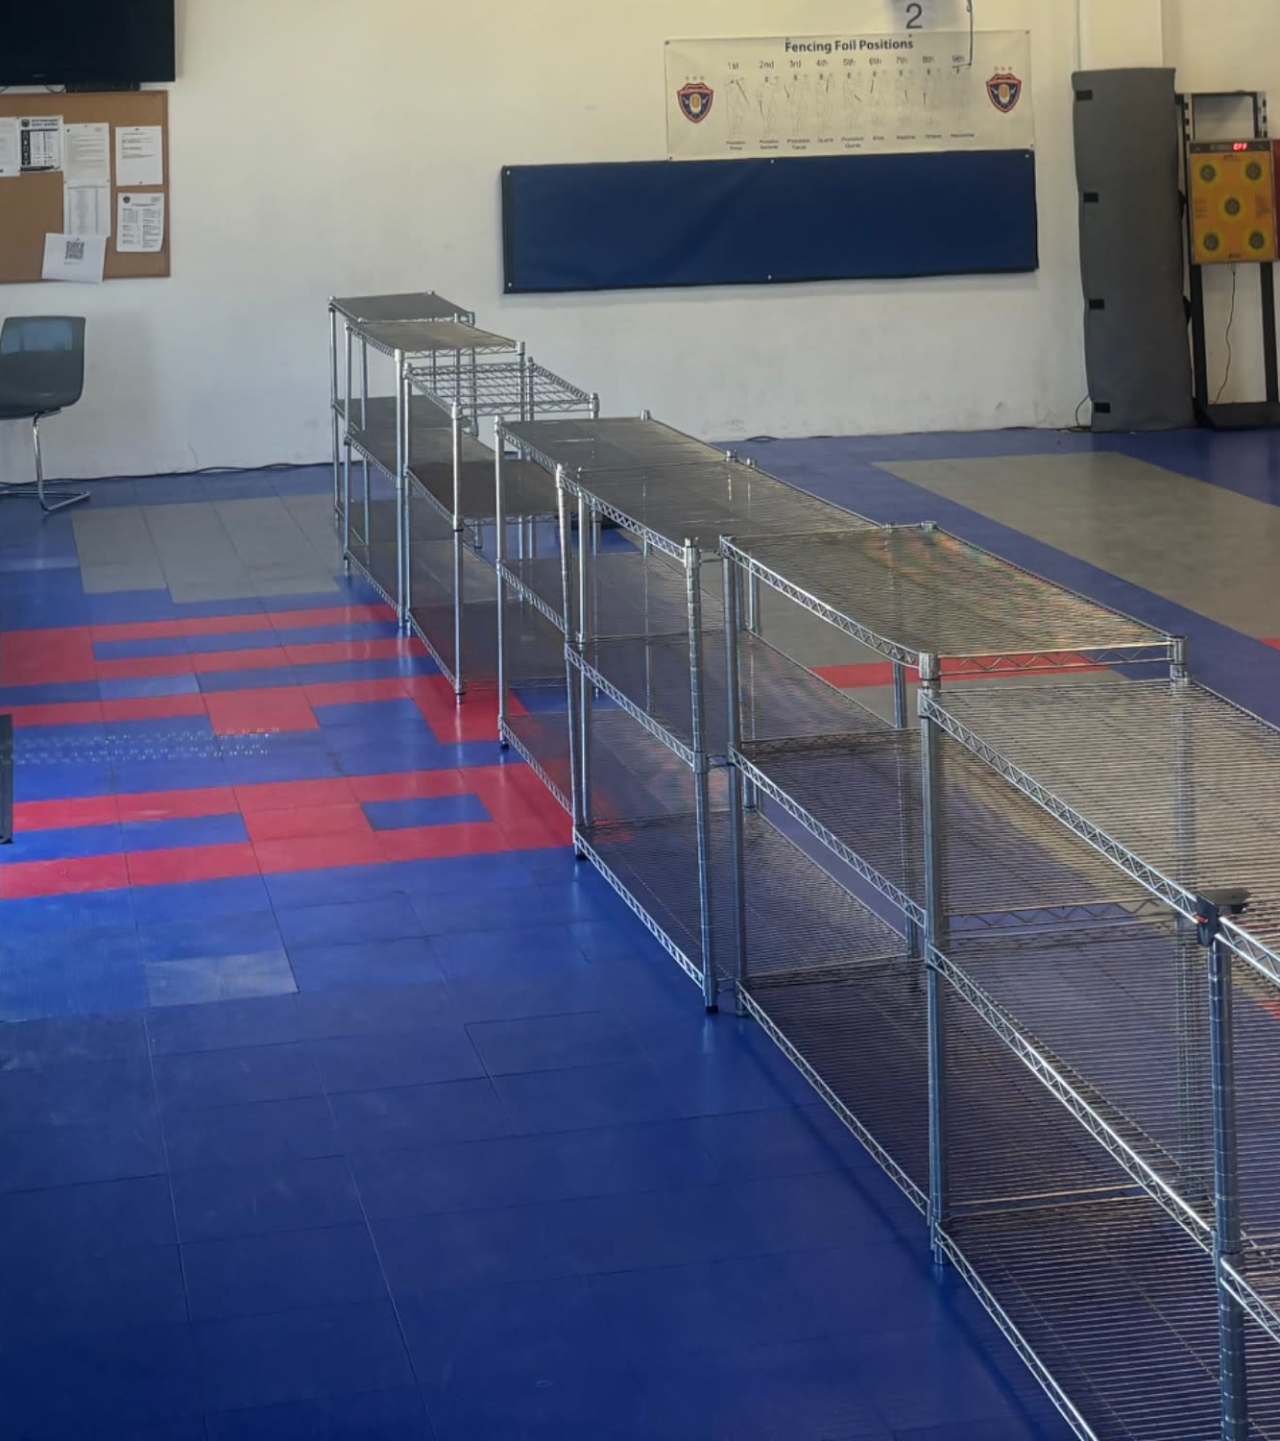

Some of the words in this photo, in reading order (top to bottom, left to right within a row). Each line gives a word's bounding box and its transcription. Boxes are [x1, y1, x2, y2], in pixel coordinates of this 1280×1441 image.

[905, 2, 923, 29] 2
[784, 41, 832, 54] Fencing
[835, 40, 856, 51] Foil
[859, 39, 914, 51] Positions
